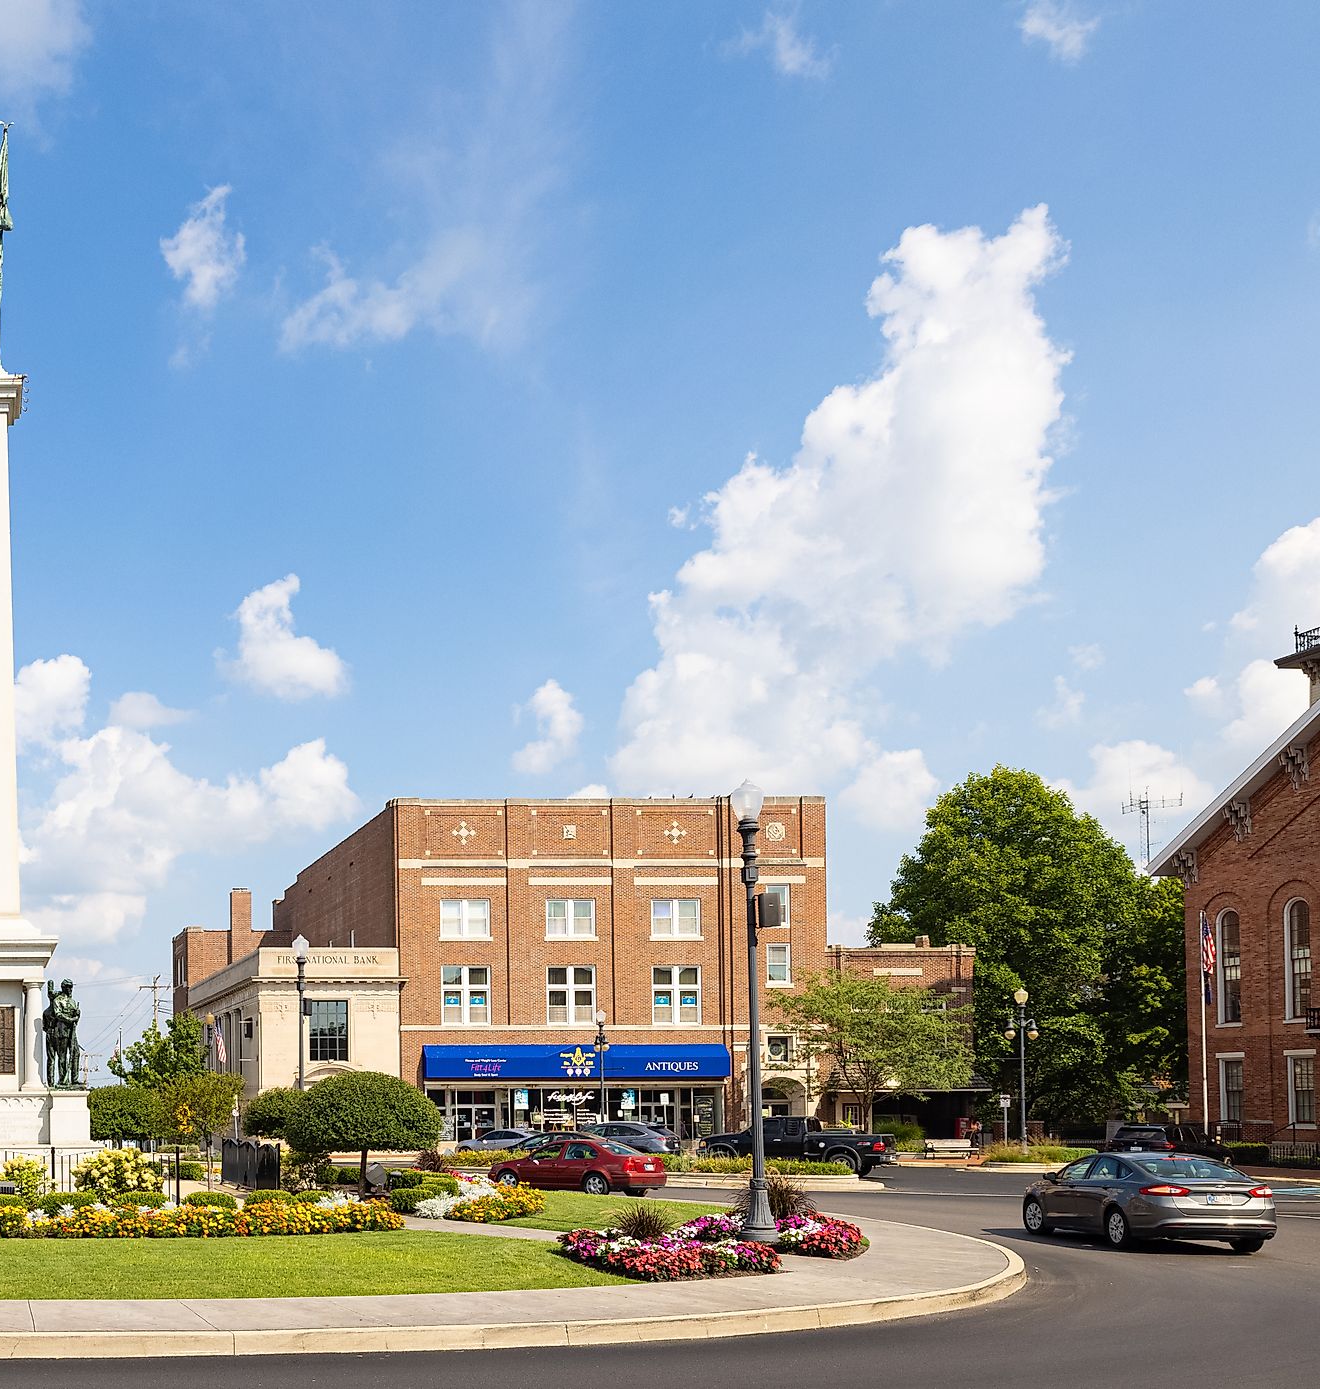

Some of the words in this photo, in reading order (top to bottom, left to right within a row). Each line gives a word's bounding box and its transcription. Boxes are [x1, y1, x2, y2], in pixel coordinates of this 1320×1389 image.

[277, 956, 297, 964] FIRS
[354, 956, 379, 964] BANK
[645, 1062, 698, 1072] ANTIQUES
